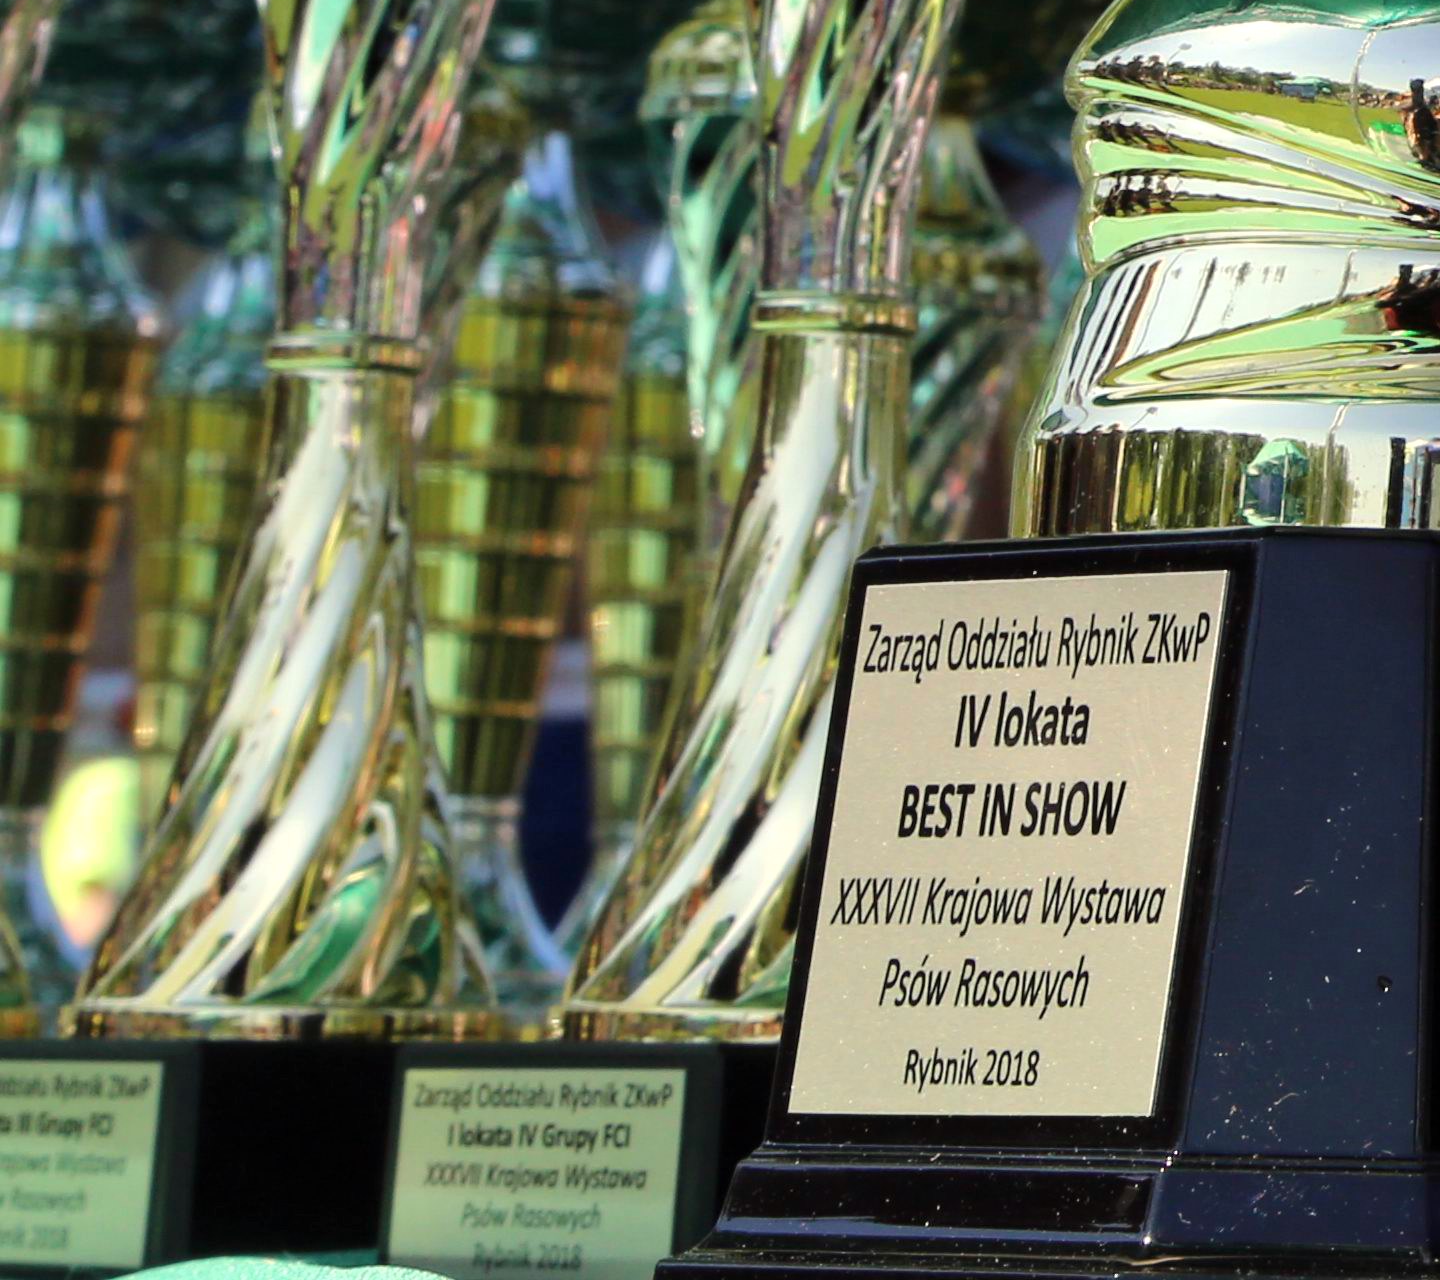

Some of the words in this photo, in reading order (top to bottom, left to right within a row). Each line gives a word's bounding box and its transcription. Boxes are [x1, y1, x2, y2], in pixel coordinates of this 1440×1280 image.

[863, 619, 944, 684] Zarząd
[948, 616, 1051, 671] Oddziału
[1057, 612, 1138, 679] Rybnik
[1142, 612, 1210, 664] ZKwP
[955, 695, 991, 748] IV
[994, 690, 1089, 747] lokata
[898, 784, 976, 838] BEST
[979, 783, 1016, 837] IN
[1020, 781, 1127, 837] SHOW
[830, 878, 920, 925] XXXVII
[922, 877, 1033, 937] Krajowa
[1041, 876, 1166, 937] Wystawa
[879, 954, 951, 1007] Psów
[954, 955, 1089, 1020] Rasowych
[904, 1047, 978, 1093] Rybnik
[982, 1050, 1040, 1086] 2018
[414, 1082, 473, 1114] Zarząd
[477, 1082, 554, 1108] Oddziału
[558, 1082, 618, 1114] Rybnik
[624, 1082, 673, 1108] ZKwP
[457, 1121, 512, 1148] lokata
[518, 1123, 539, 1147] IV
[542, 1122, 599, 1153] Grupy
[602, 1124, 630, 1148] FCI
[485, 1162, 559, 1192] Krajowa
[564, 1162, 648, 1192] Wystawa
[460, 1202, 509, 1228] Psów
[511, 1202, 602, 1233] Rasowych
